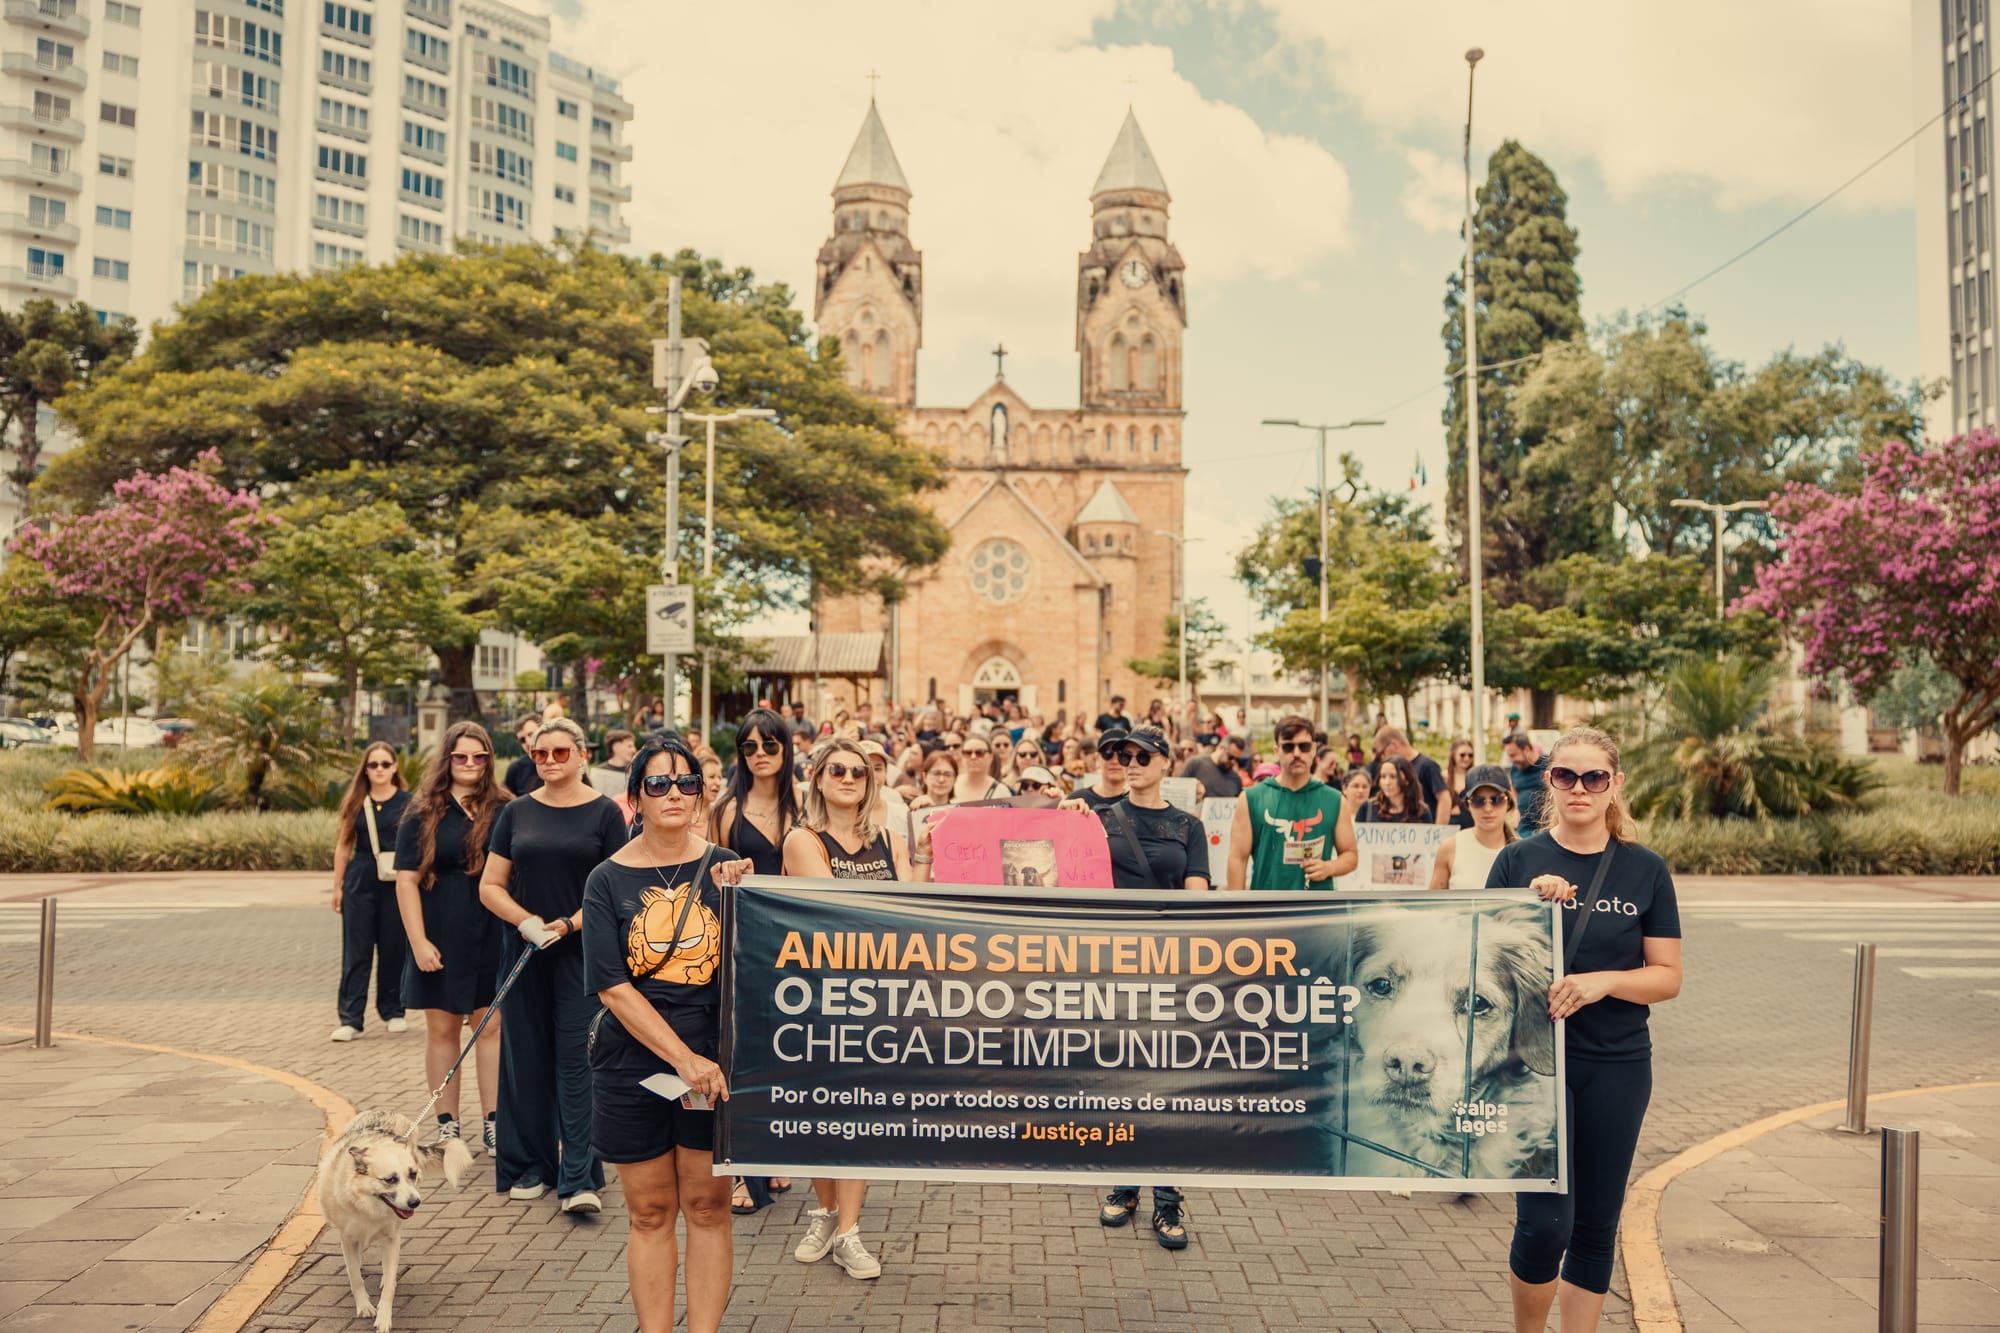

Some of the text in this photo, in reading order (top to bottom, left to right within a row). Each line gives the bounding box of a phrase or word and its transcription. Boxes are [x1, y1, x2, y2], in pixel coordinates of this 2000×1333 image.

[831, 856, 888, 872] defiance
[775, 931, 1311, 977] ANIMAIS SENTEM DOR.
[774, 976, 1362, 1030] O ESTADO SENTE O QUÊ?
[773, 1023, 1309, 1071] CHEGA DE IMPUNIDADE!
[771, 1086, 1307, 1113] Por Orelha e por todos os crimes de maus tratos
[1468, 1099, 1508, 1119] alpa
[769, 1118, 1135, 1146] que seguem impunes! Justiça já!
[1455, 1116, 1508, 1137] lages
